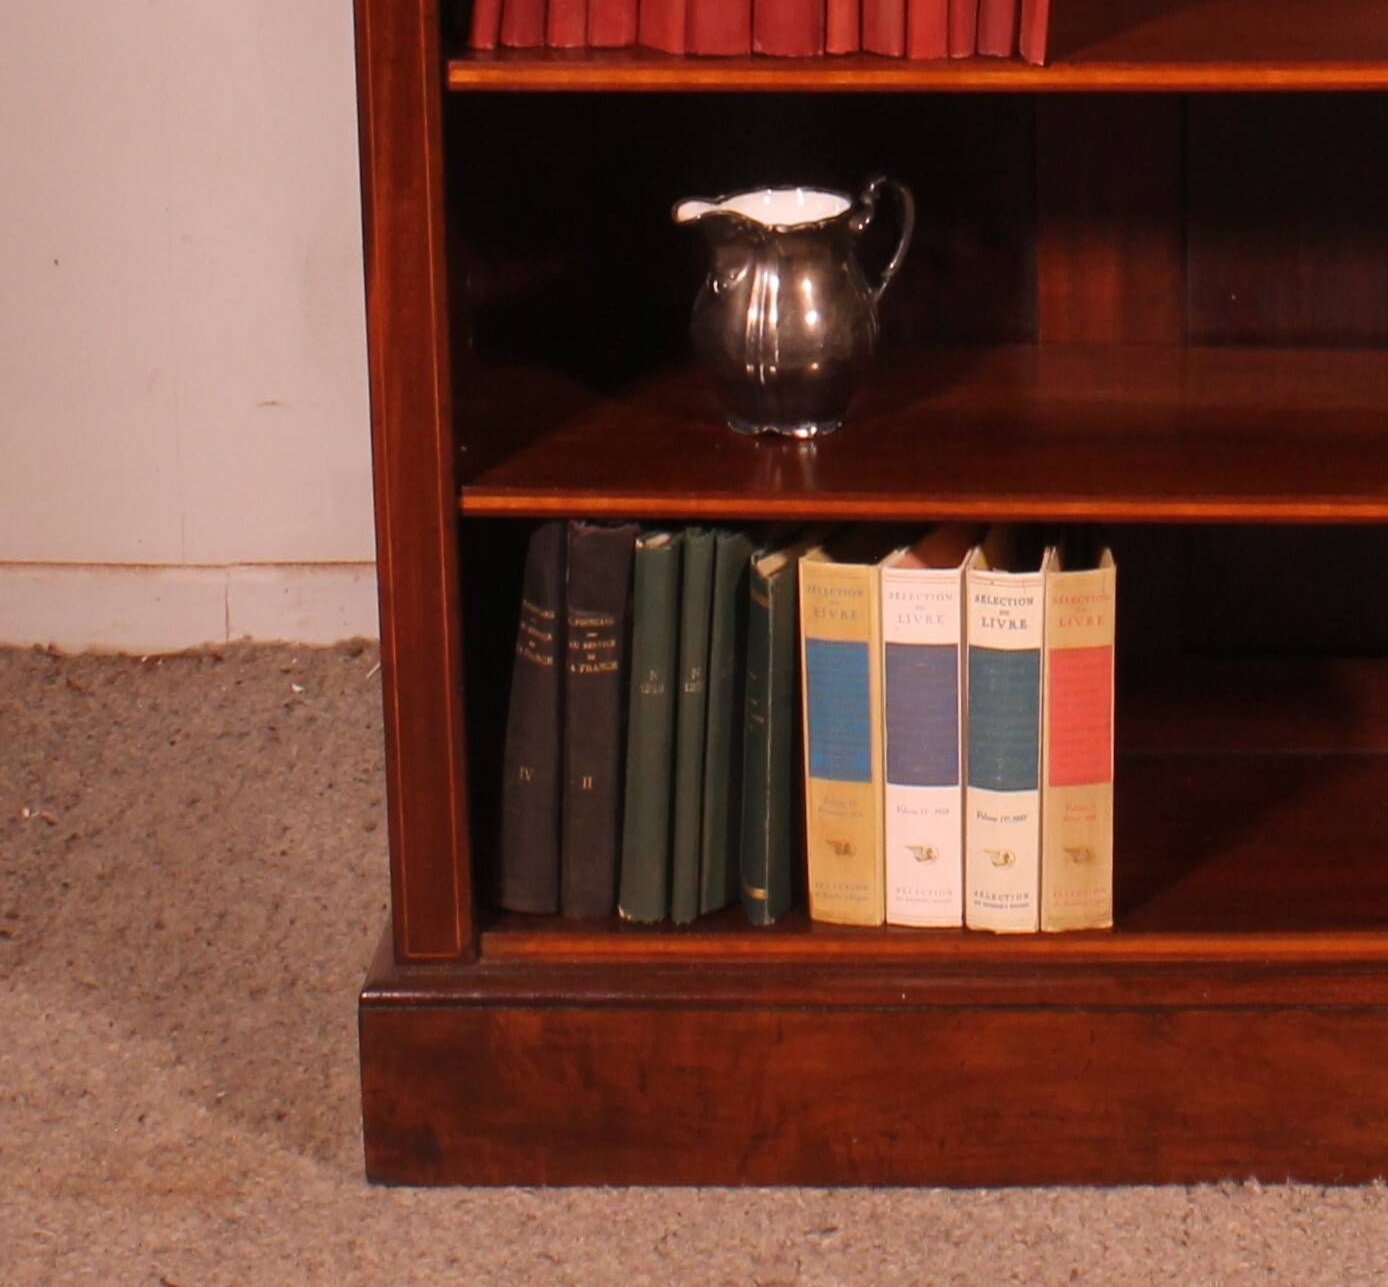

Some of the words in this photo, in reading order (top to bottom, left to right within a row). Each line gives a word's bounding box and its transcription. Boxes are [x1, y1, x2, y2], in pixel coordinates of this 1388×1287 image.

[814, 609, 857, 620] LIVRE
[897, 615, 945, 625] LIVRE
[981, 617, 1028, 630] LIVRE
[1059, 615, 1106, 628] LIVRE
[581, 776, 593, 790] II
